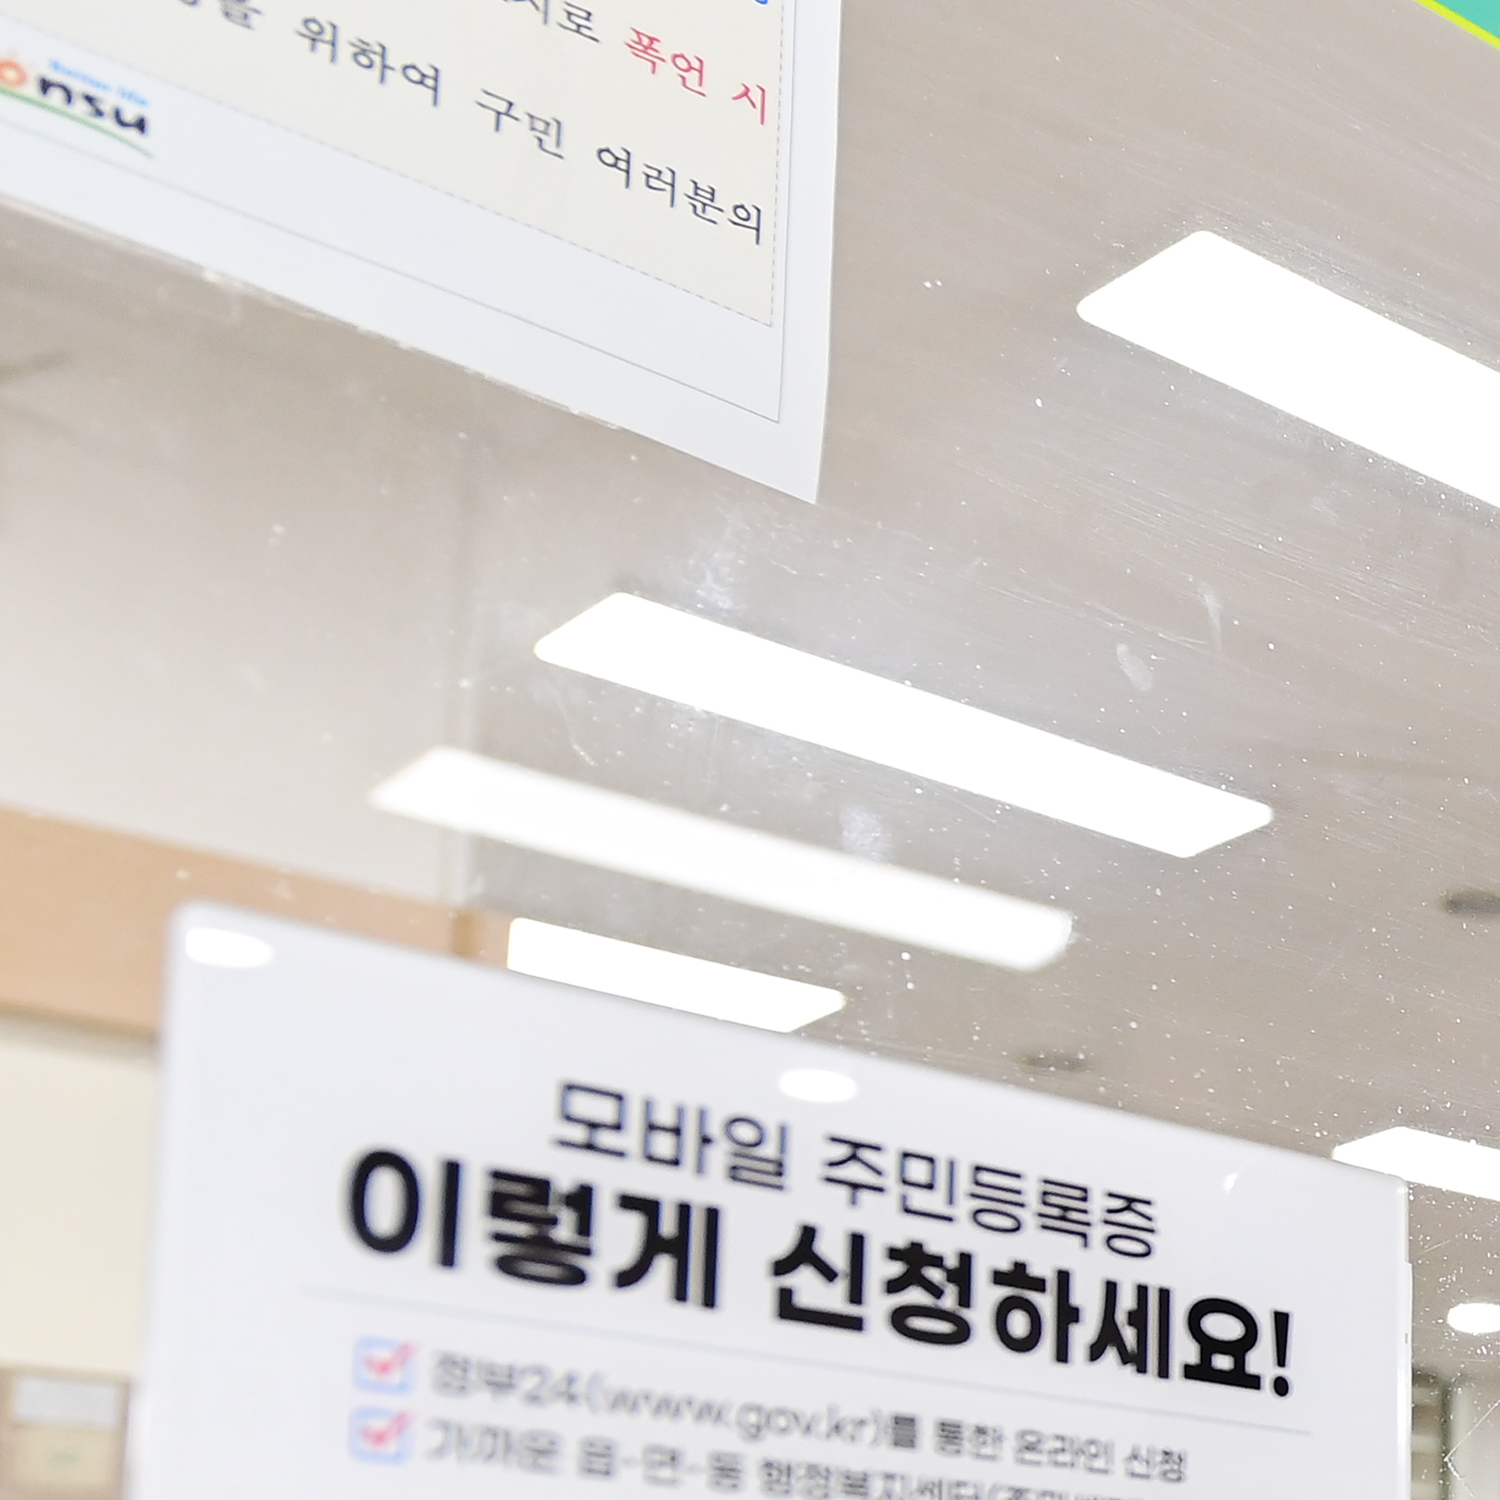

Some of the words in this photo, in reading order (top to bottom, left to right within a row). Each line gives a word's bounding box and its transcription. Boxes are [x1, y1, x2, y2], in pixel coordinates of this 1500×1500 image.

[294, 16, 442, 107] 위하여
[474, 88, 565, 160] 구민
[596, 146, 762, 245] 여러분의
[623, 27, 707, 97] 폭언
[731, 83, 766, 125] 시
[552, 1077, 794, 1192] 모바일
[819, 1131, 1159, 1262] 주민등록증
[344, 1145, 720, 1311] 이렇게
[767, 1217, 1293, 1398] 신청하세요!
[427, 1417, 561, 1476] 가까운
[933, 1420, 1003, 1461] 통한
[1012, 1430, 1114, 1475] 온라인
[1125, 1442, 1187, 1485] 신청
